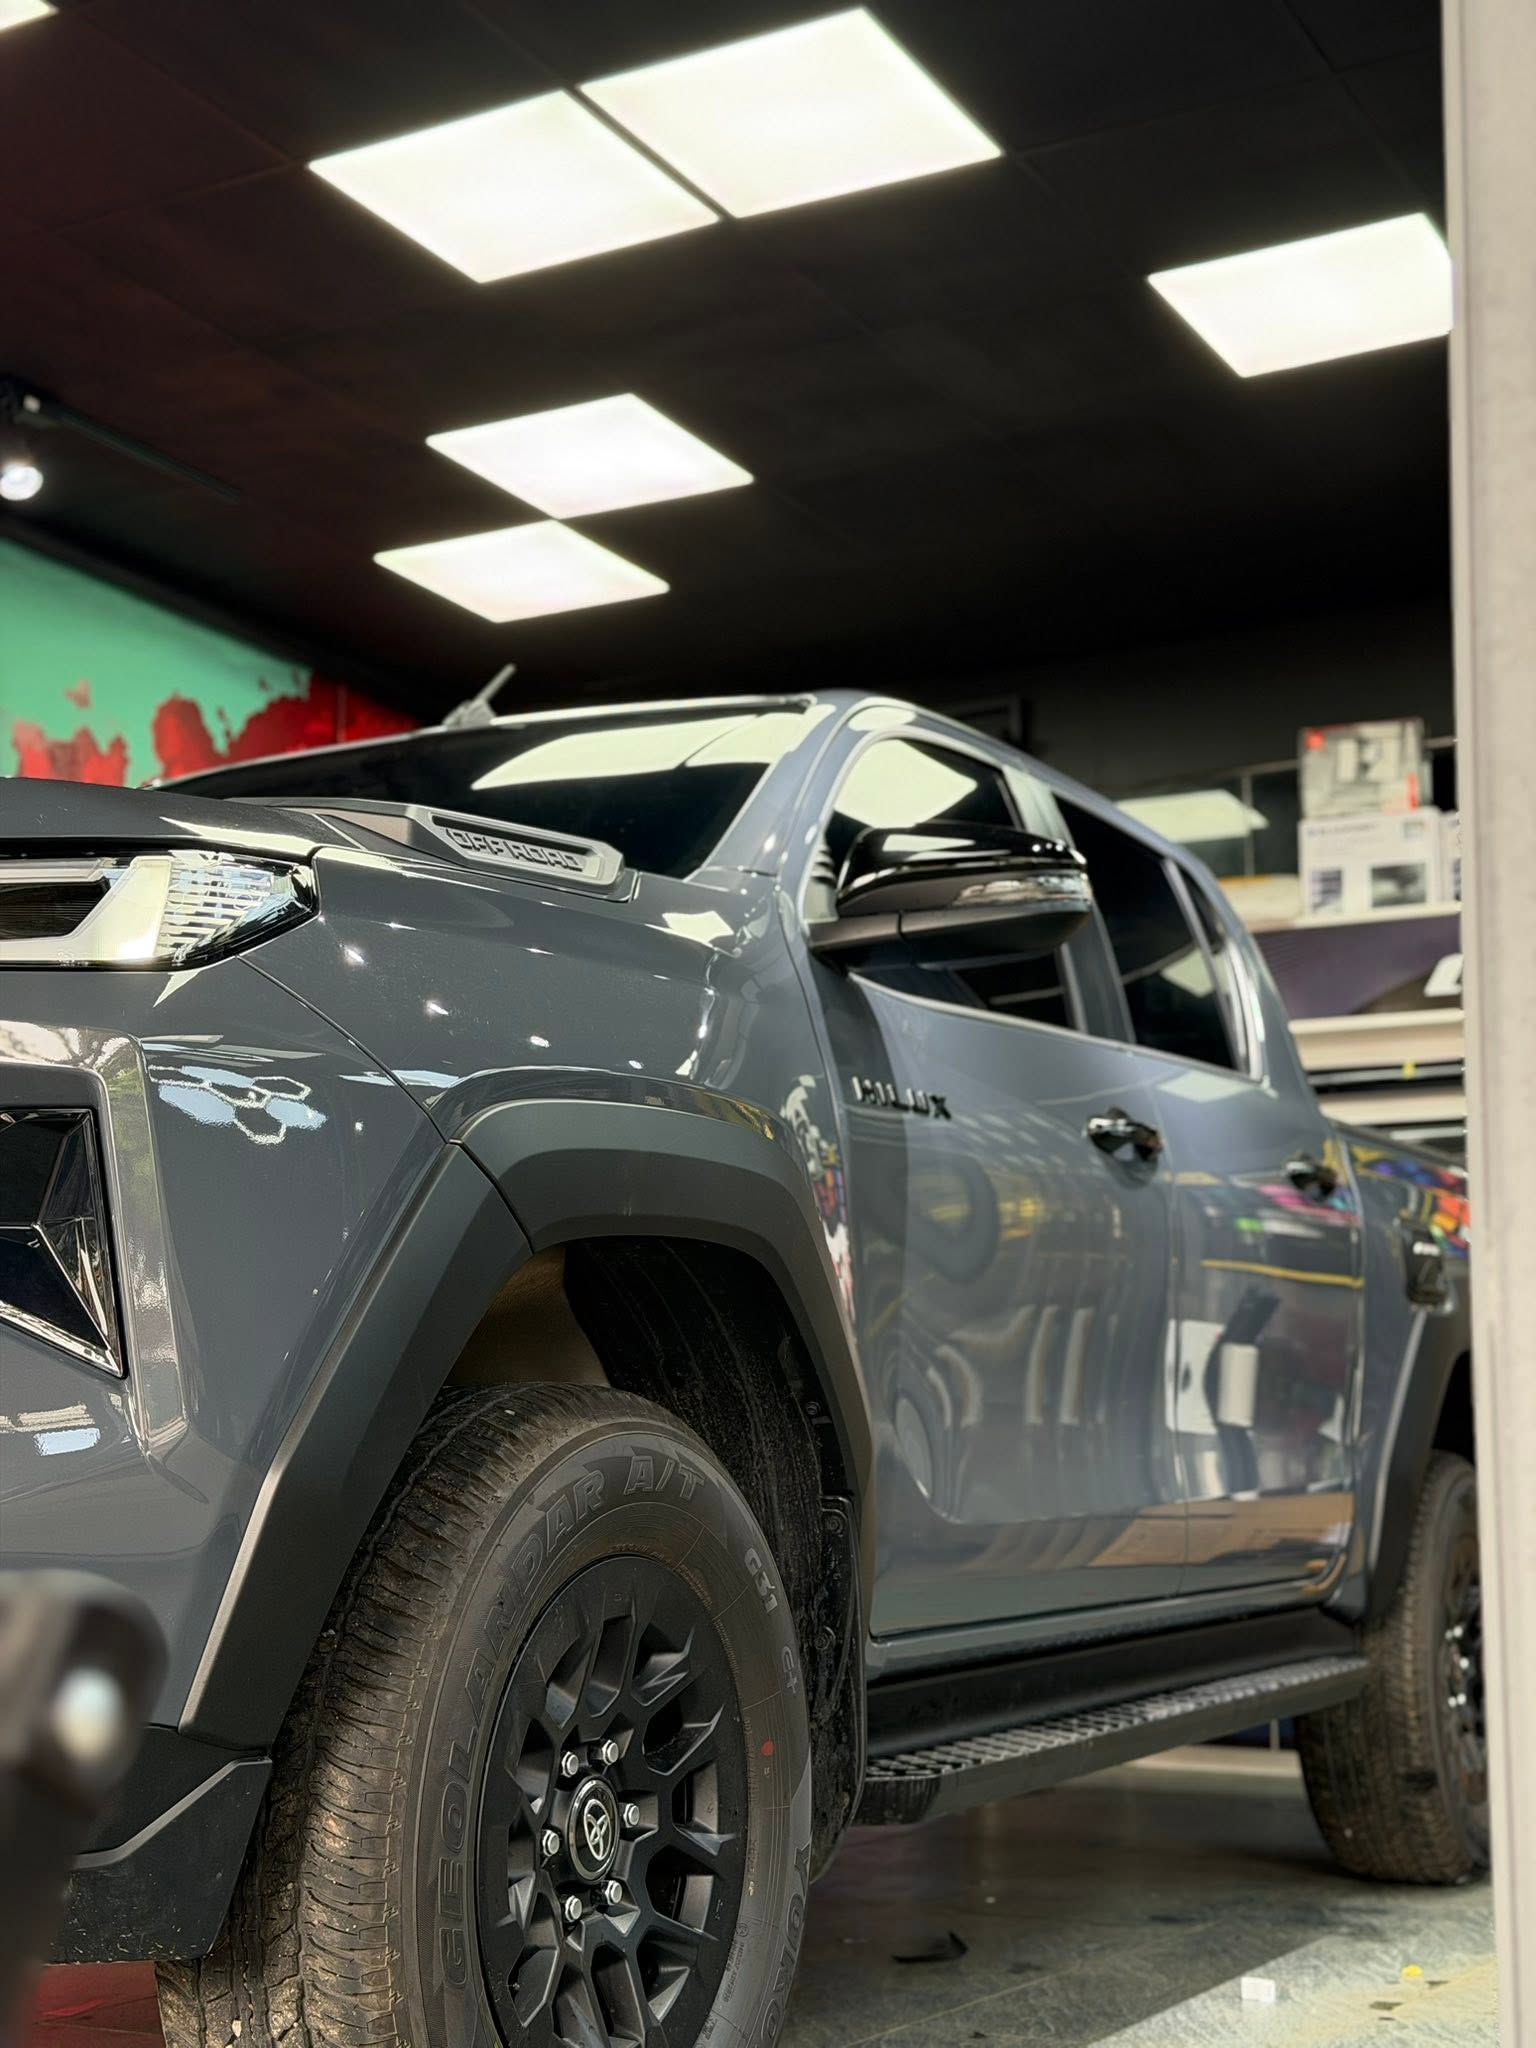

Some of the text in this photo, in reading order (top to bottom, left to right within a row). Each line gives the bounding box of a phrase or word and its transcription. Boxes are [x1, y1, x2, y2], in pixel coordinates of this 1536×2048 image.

[851, 1076, 952, 1120] HILUX
[437, 1466, 605, 1988] GEOLANDAR
[623, 1455, 705, 1500] A/T
[754, 1842, 812, 2048] YOKO
